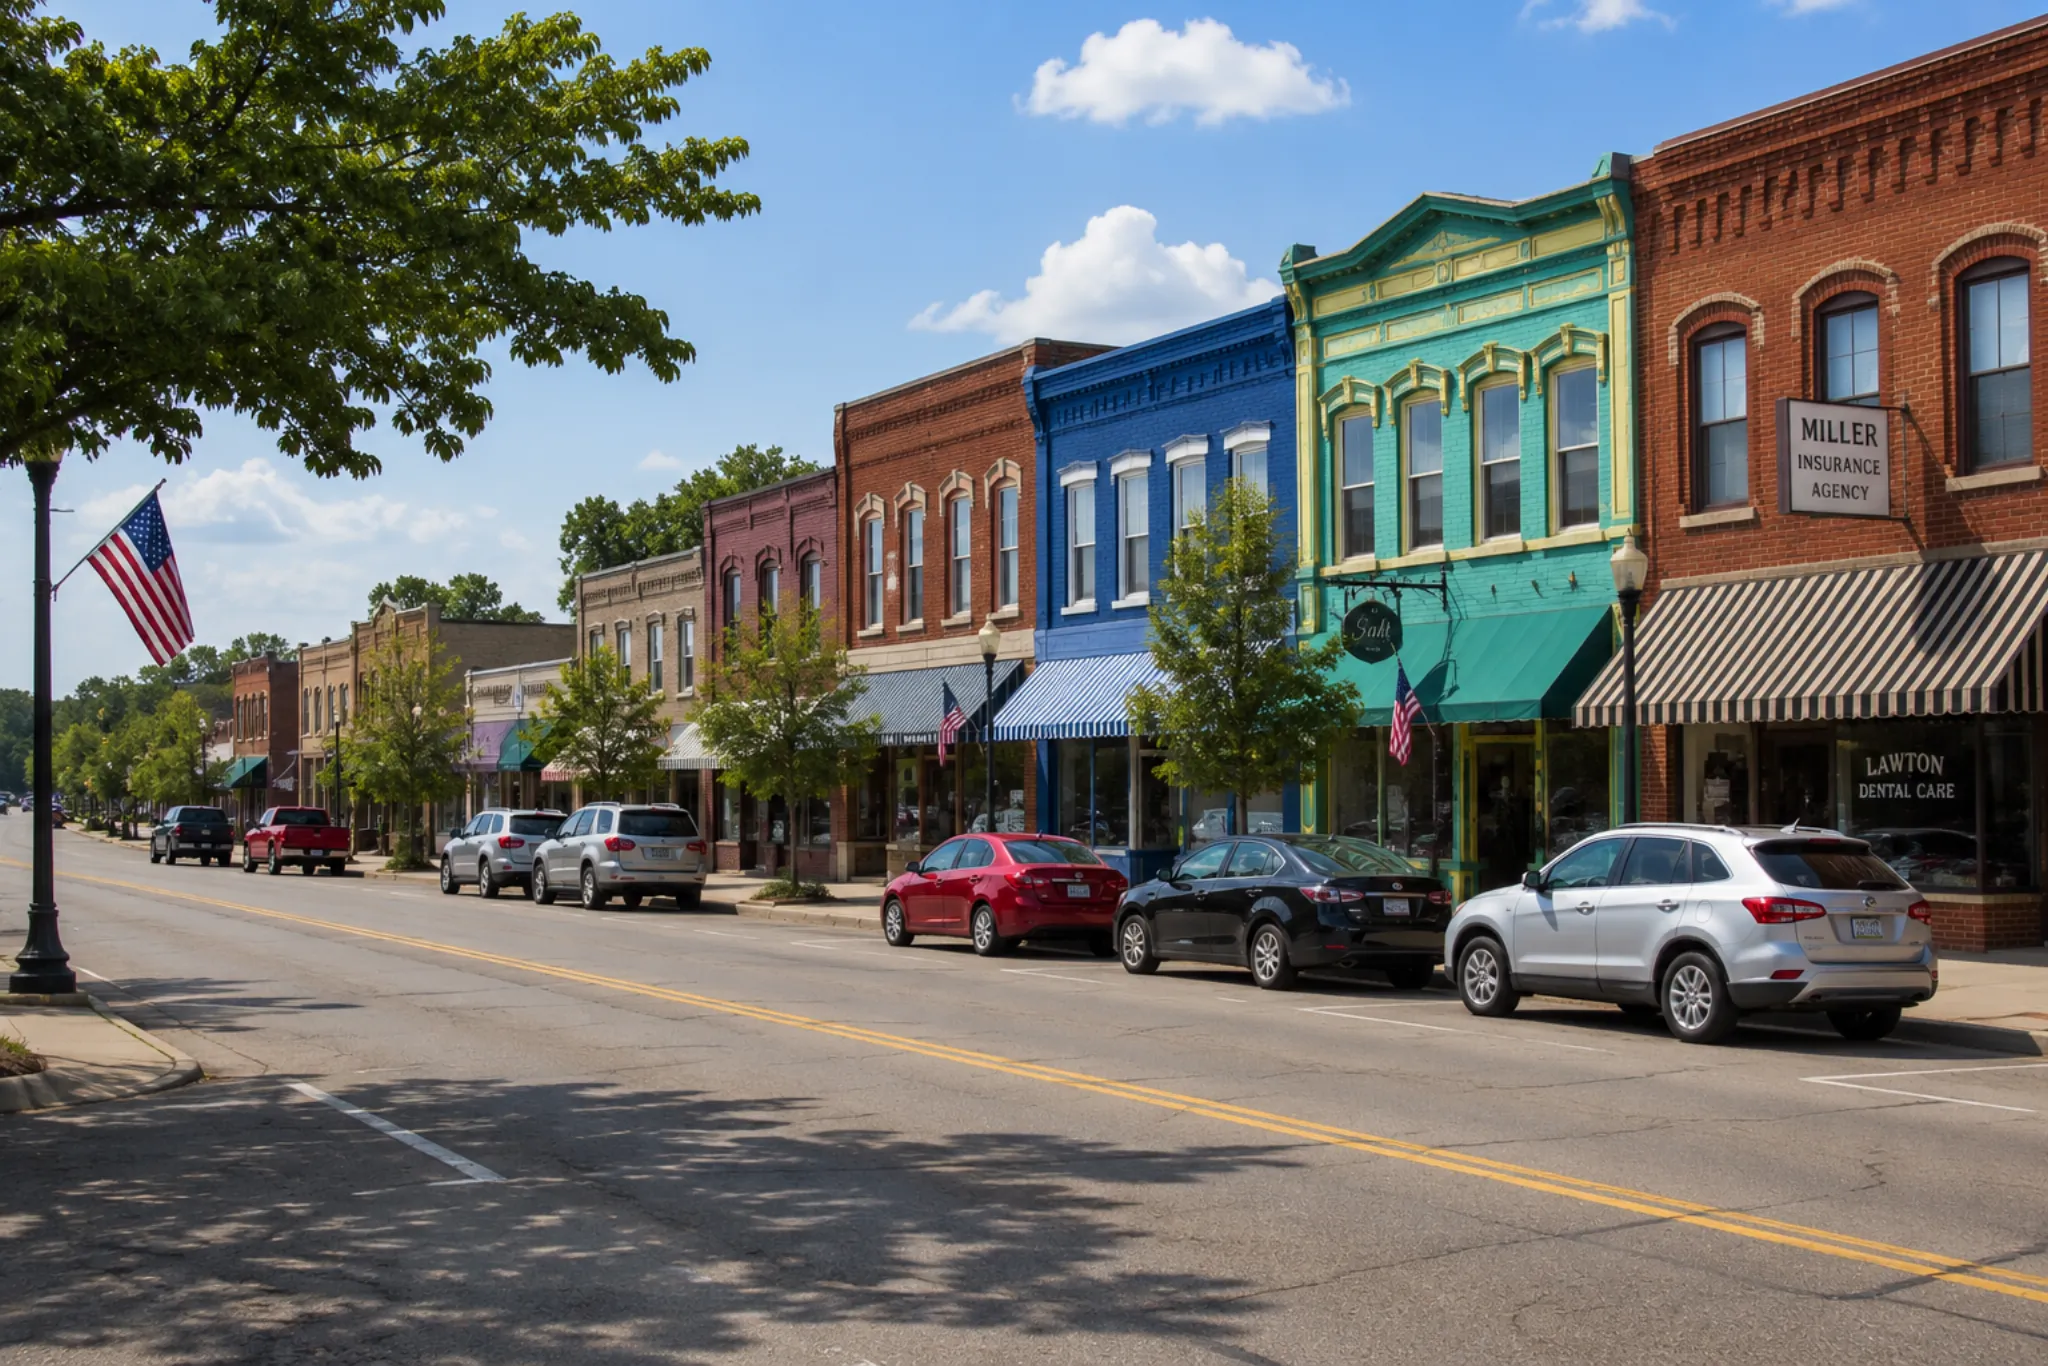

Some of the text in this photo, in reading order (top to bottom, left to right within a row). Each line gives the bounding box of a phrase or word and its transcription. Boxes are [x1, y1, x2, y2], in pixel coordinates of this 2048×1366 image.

[1801, 417, 1878, 447] MILLER
[1798, 454, 1880, 476] INSURANCE
[1811, 482, 1870, 501] AGENCY
[1866, 752, 1944, 776] LAWTON
[1859, 783, 1955, 799] DENTAL CARE
